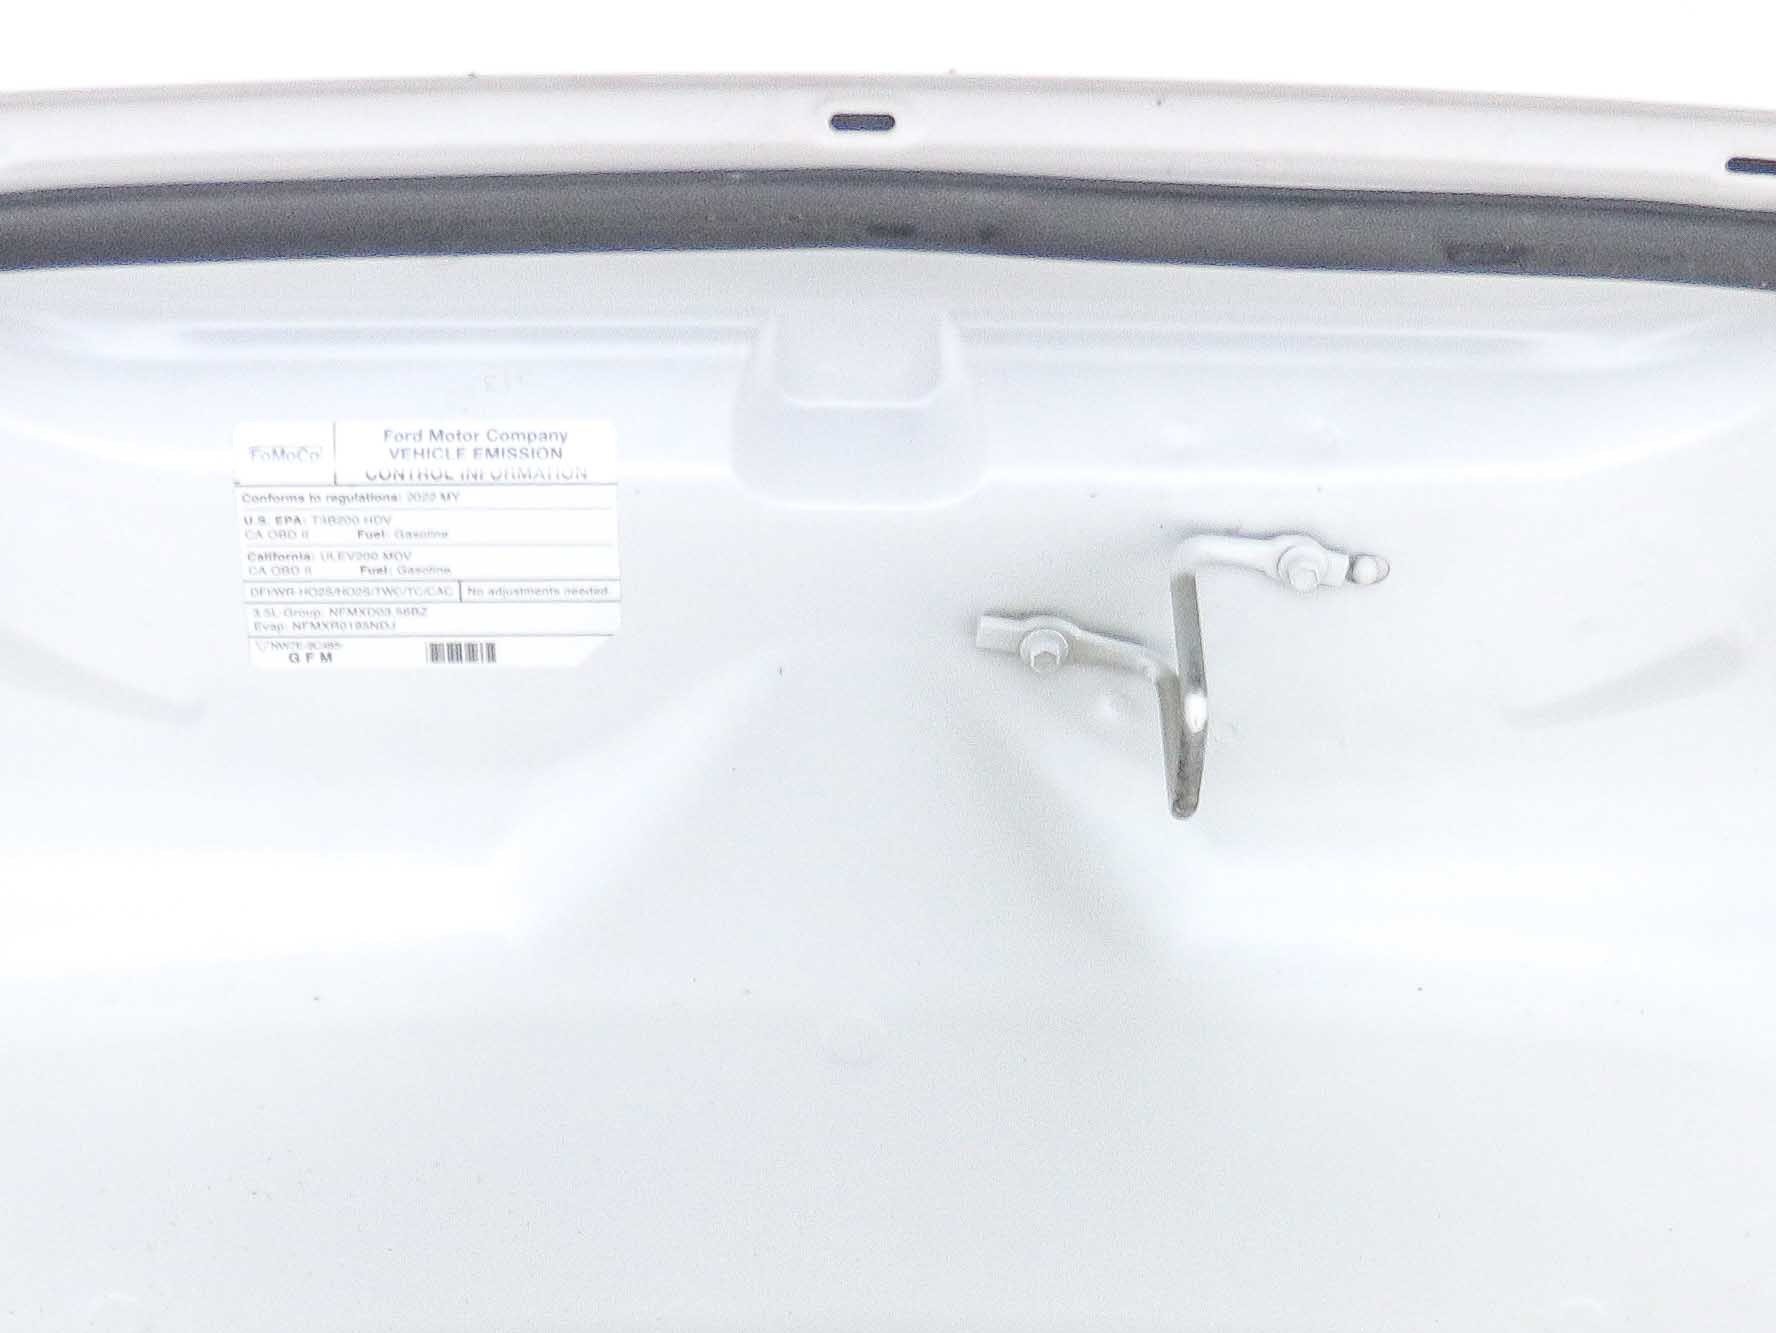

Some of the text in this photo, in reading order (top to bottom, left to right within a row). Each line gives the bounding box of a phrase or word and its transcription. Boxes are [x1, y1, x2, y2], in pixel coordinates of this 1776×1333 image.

[384, 429, 568, 444] Ford Motor Company
[389, 447, 563, 461] VEHICLE EMISSION
[242, 493, 305, 504] Conforms
[488, 586, 560, 599] adjustments
